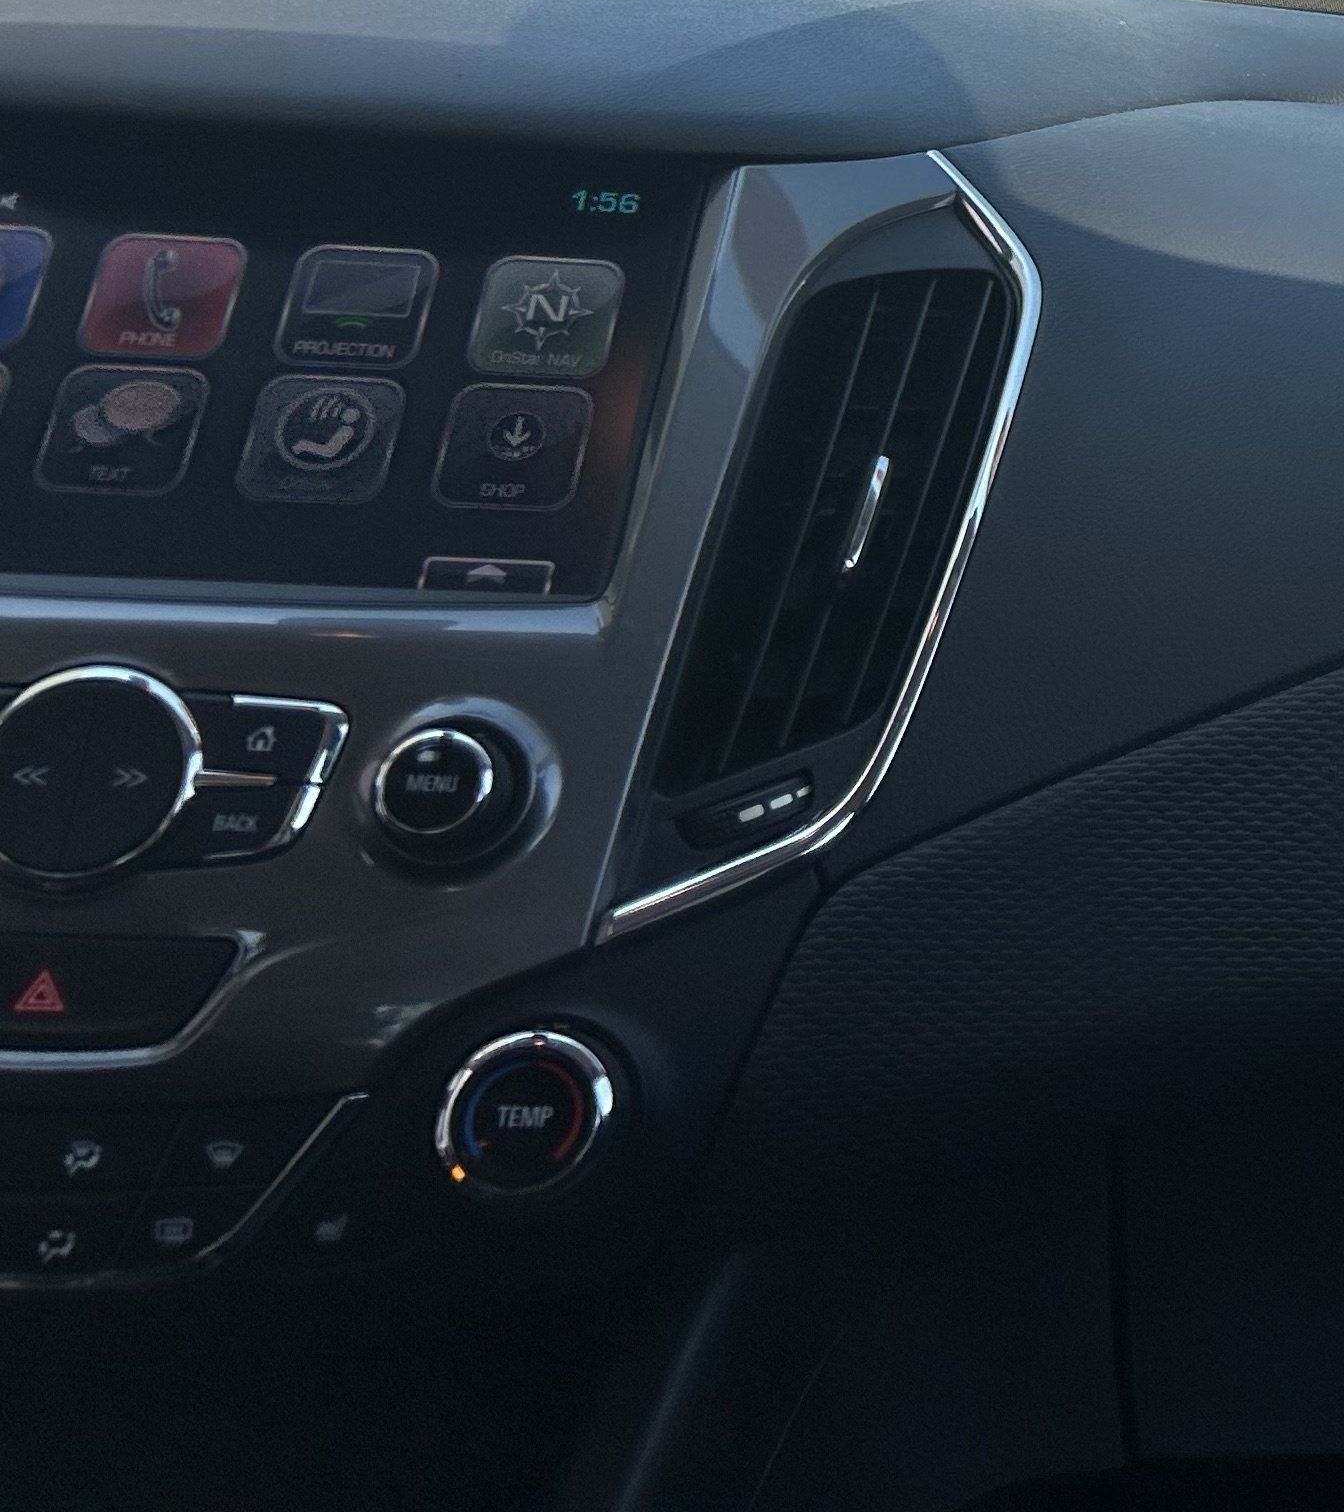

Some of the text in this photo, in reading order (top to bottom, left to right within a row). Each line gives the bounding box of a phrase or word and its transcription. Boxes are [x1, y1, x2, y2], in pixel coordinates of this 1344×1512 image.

[570, 189, 641, 215] 1:56
[118, 331, 178, 348] PHONE
[292, 340, 397, 360] PROJECTION
[547, 352, 585, 368] NAV
[479, 482, 526, 499] SHOP
[405, 773, 460, 793] MENU
[211, 814, 260, 833] BACK
[496, 1103, 556, 1131] TEMP
